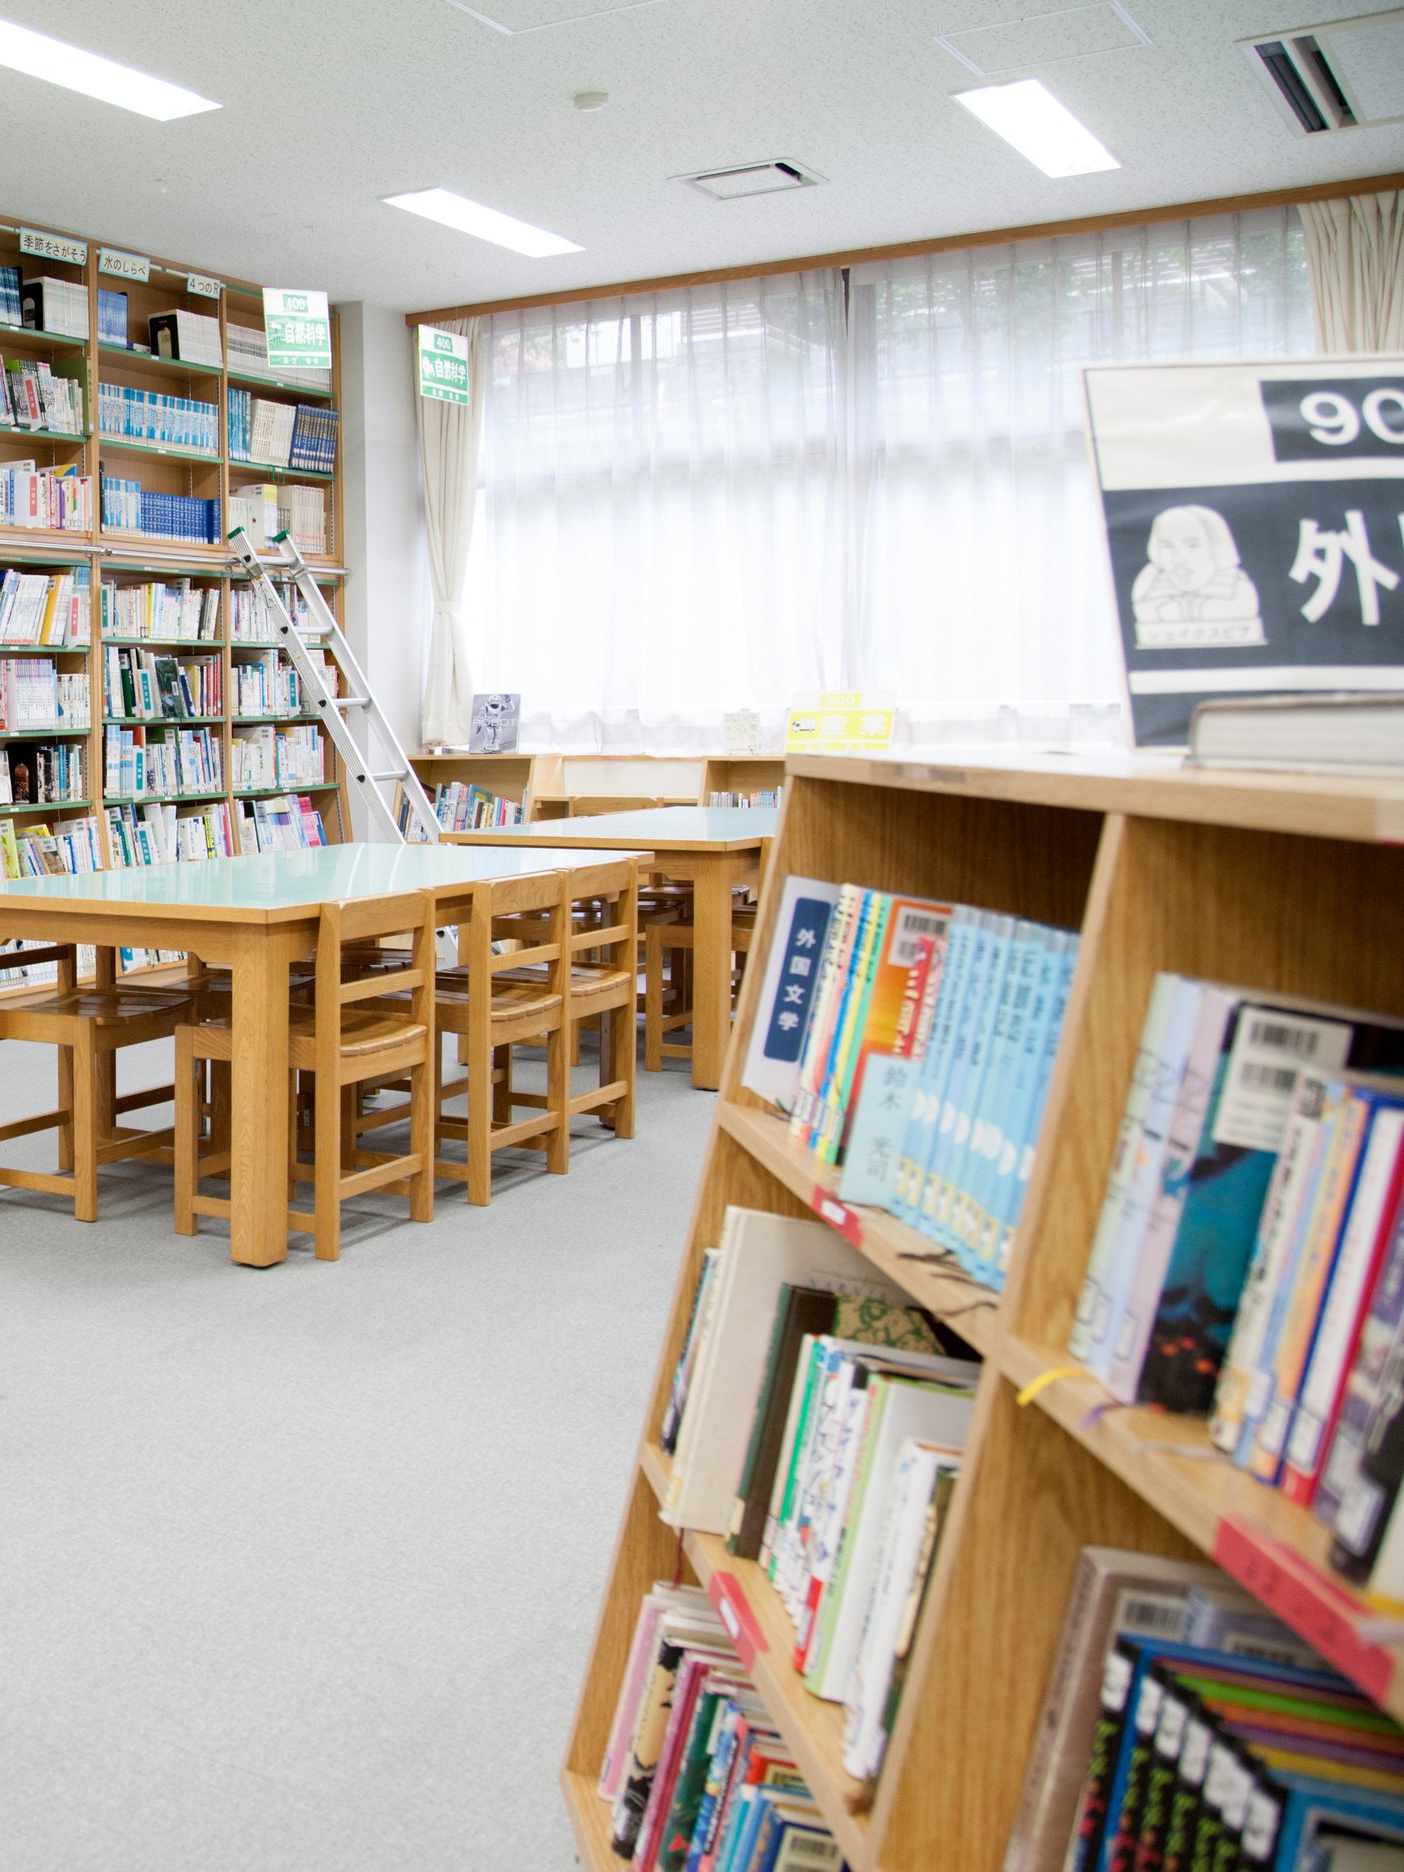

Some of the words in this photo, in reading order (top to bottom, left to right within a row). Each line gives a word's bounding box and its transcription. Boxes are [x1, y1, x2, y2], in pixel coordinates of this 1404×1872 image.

[23, 235, 86, 263] 季節をさがそう
[103, 256, 146, 276] 水のしらべ
[284, 322, 327, 346] 自然科学
[436, 336, 452, 350] 400
[434, 359, 467, 385] 自然科学
[1288, 509, 1404, 627] 外
[777, 927, 816, 1032] 外国文学
